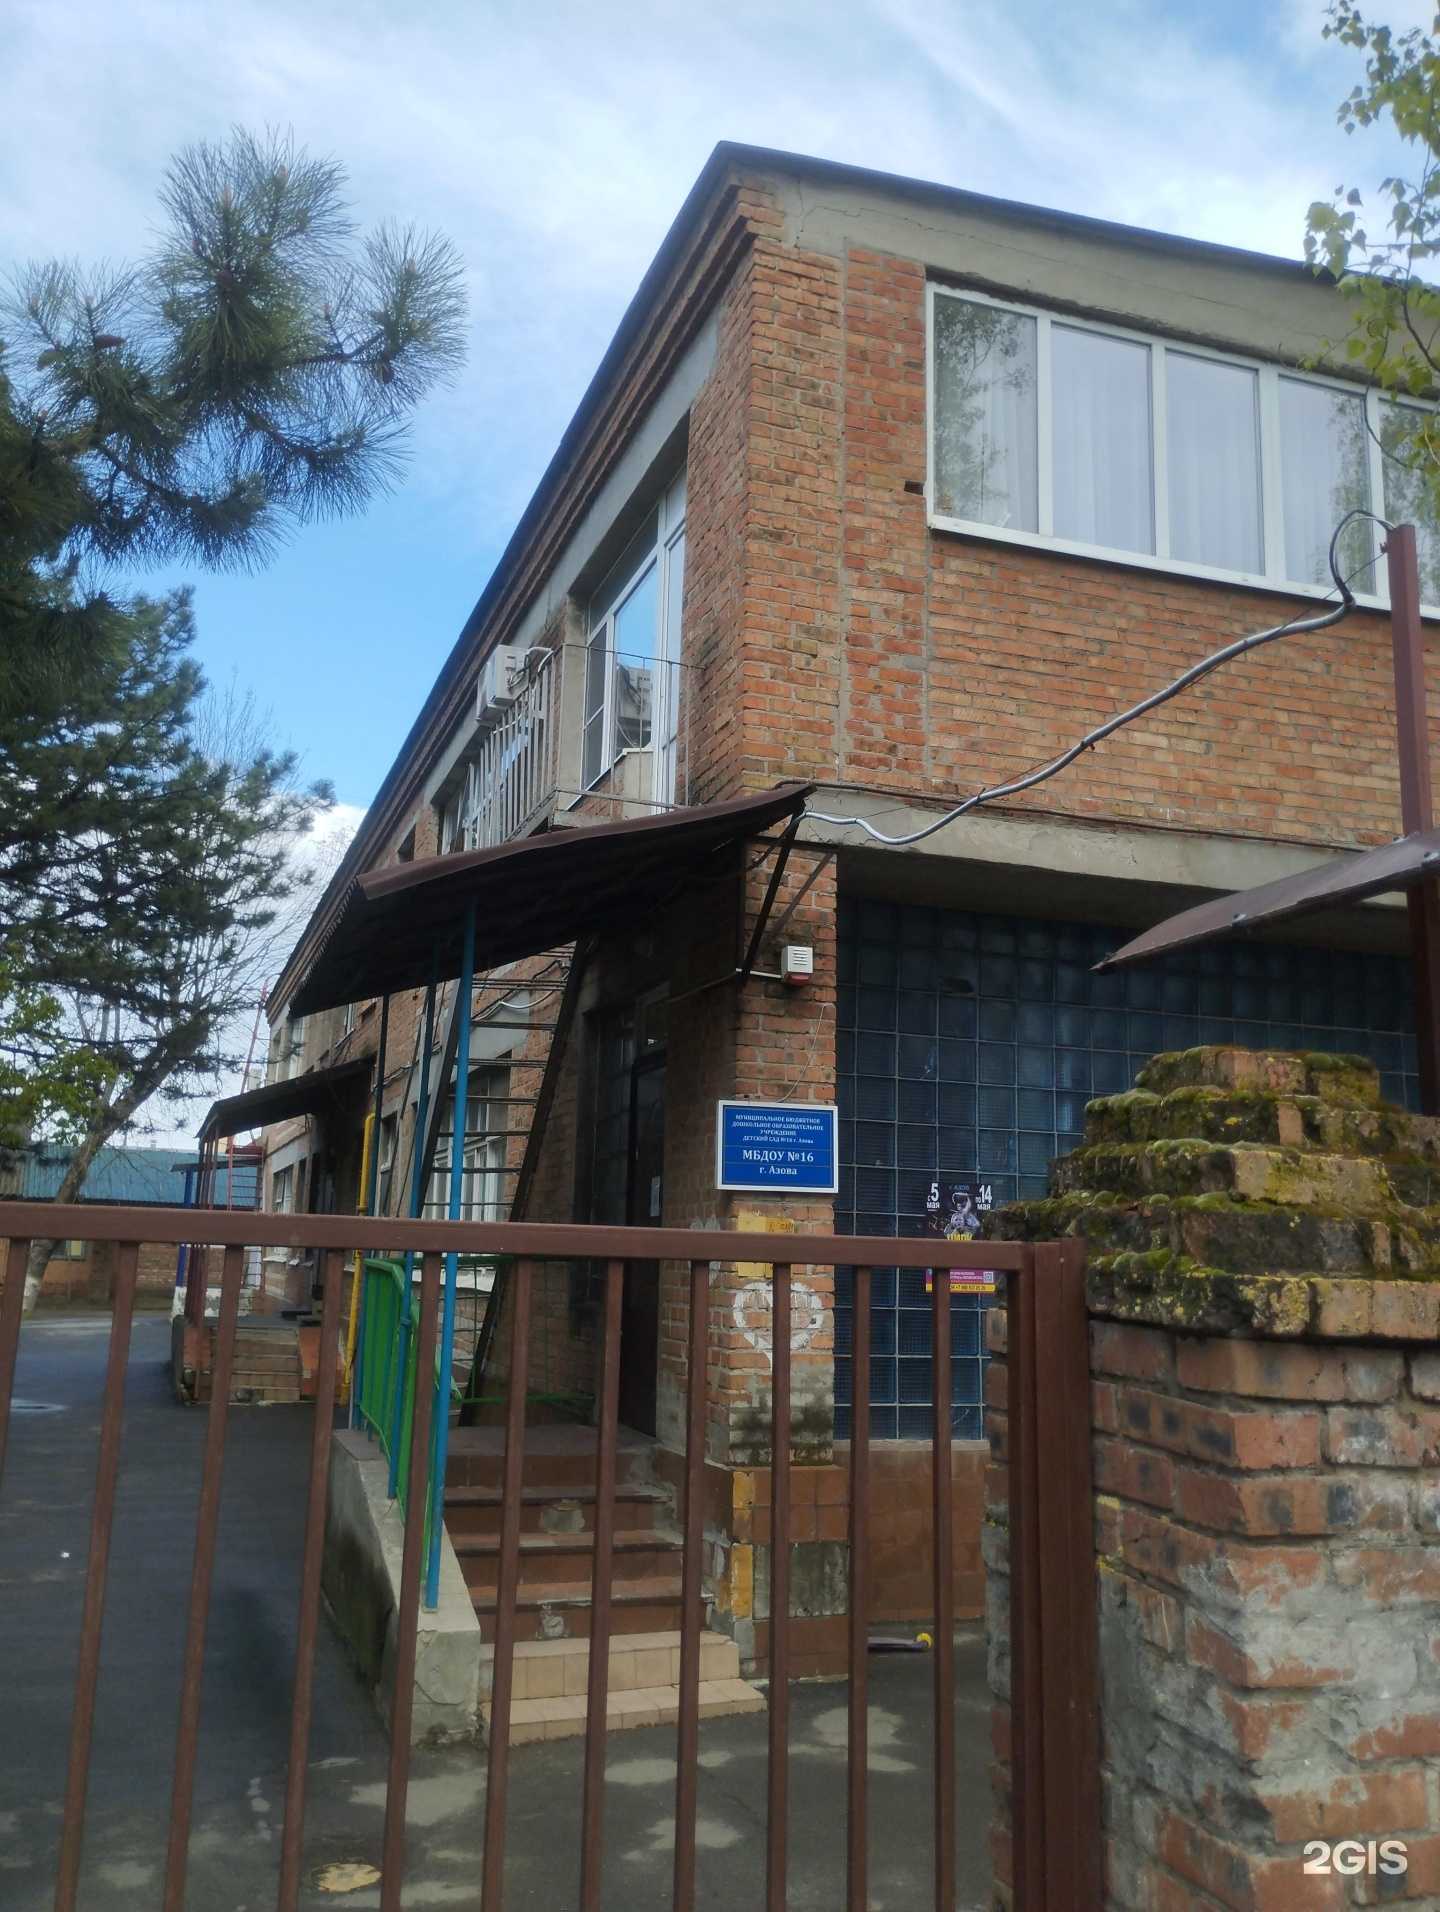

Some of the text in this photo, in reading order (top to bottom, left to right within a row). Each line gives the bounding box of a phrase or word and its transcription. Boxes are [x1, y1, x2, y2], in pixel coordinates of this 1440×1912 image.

[742, 1149, 814, 1162] МБДОУ №16
[768, 1165, 798, 1175] Азова
[931, 1183, 939, 1202] 5
[979, 1185, 992, 1204] 14
